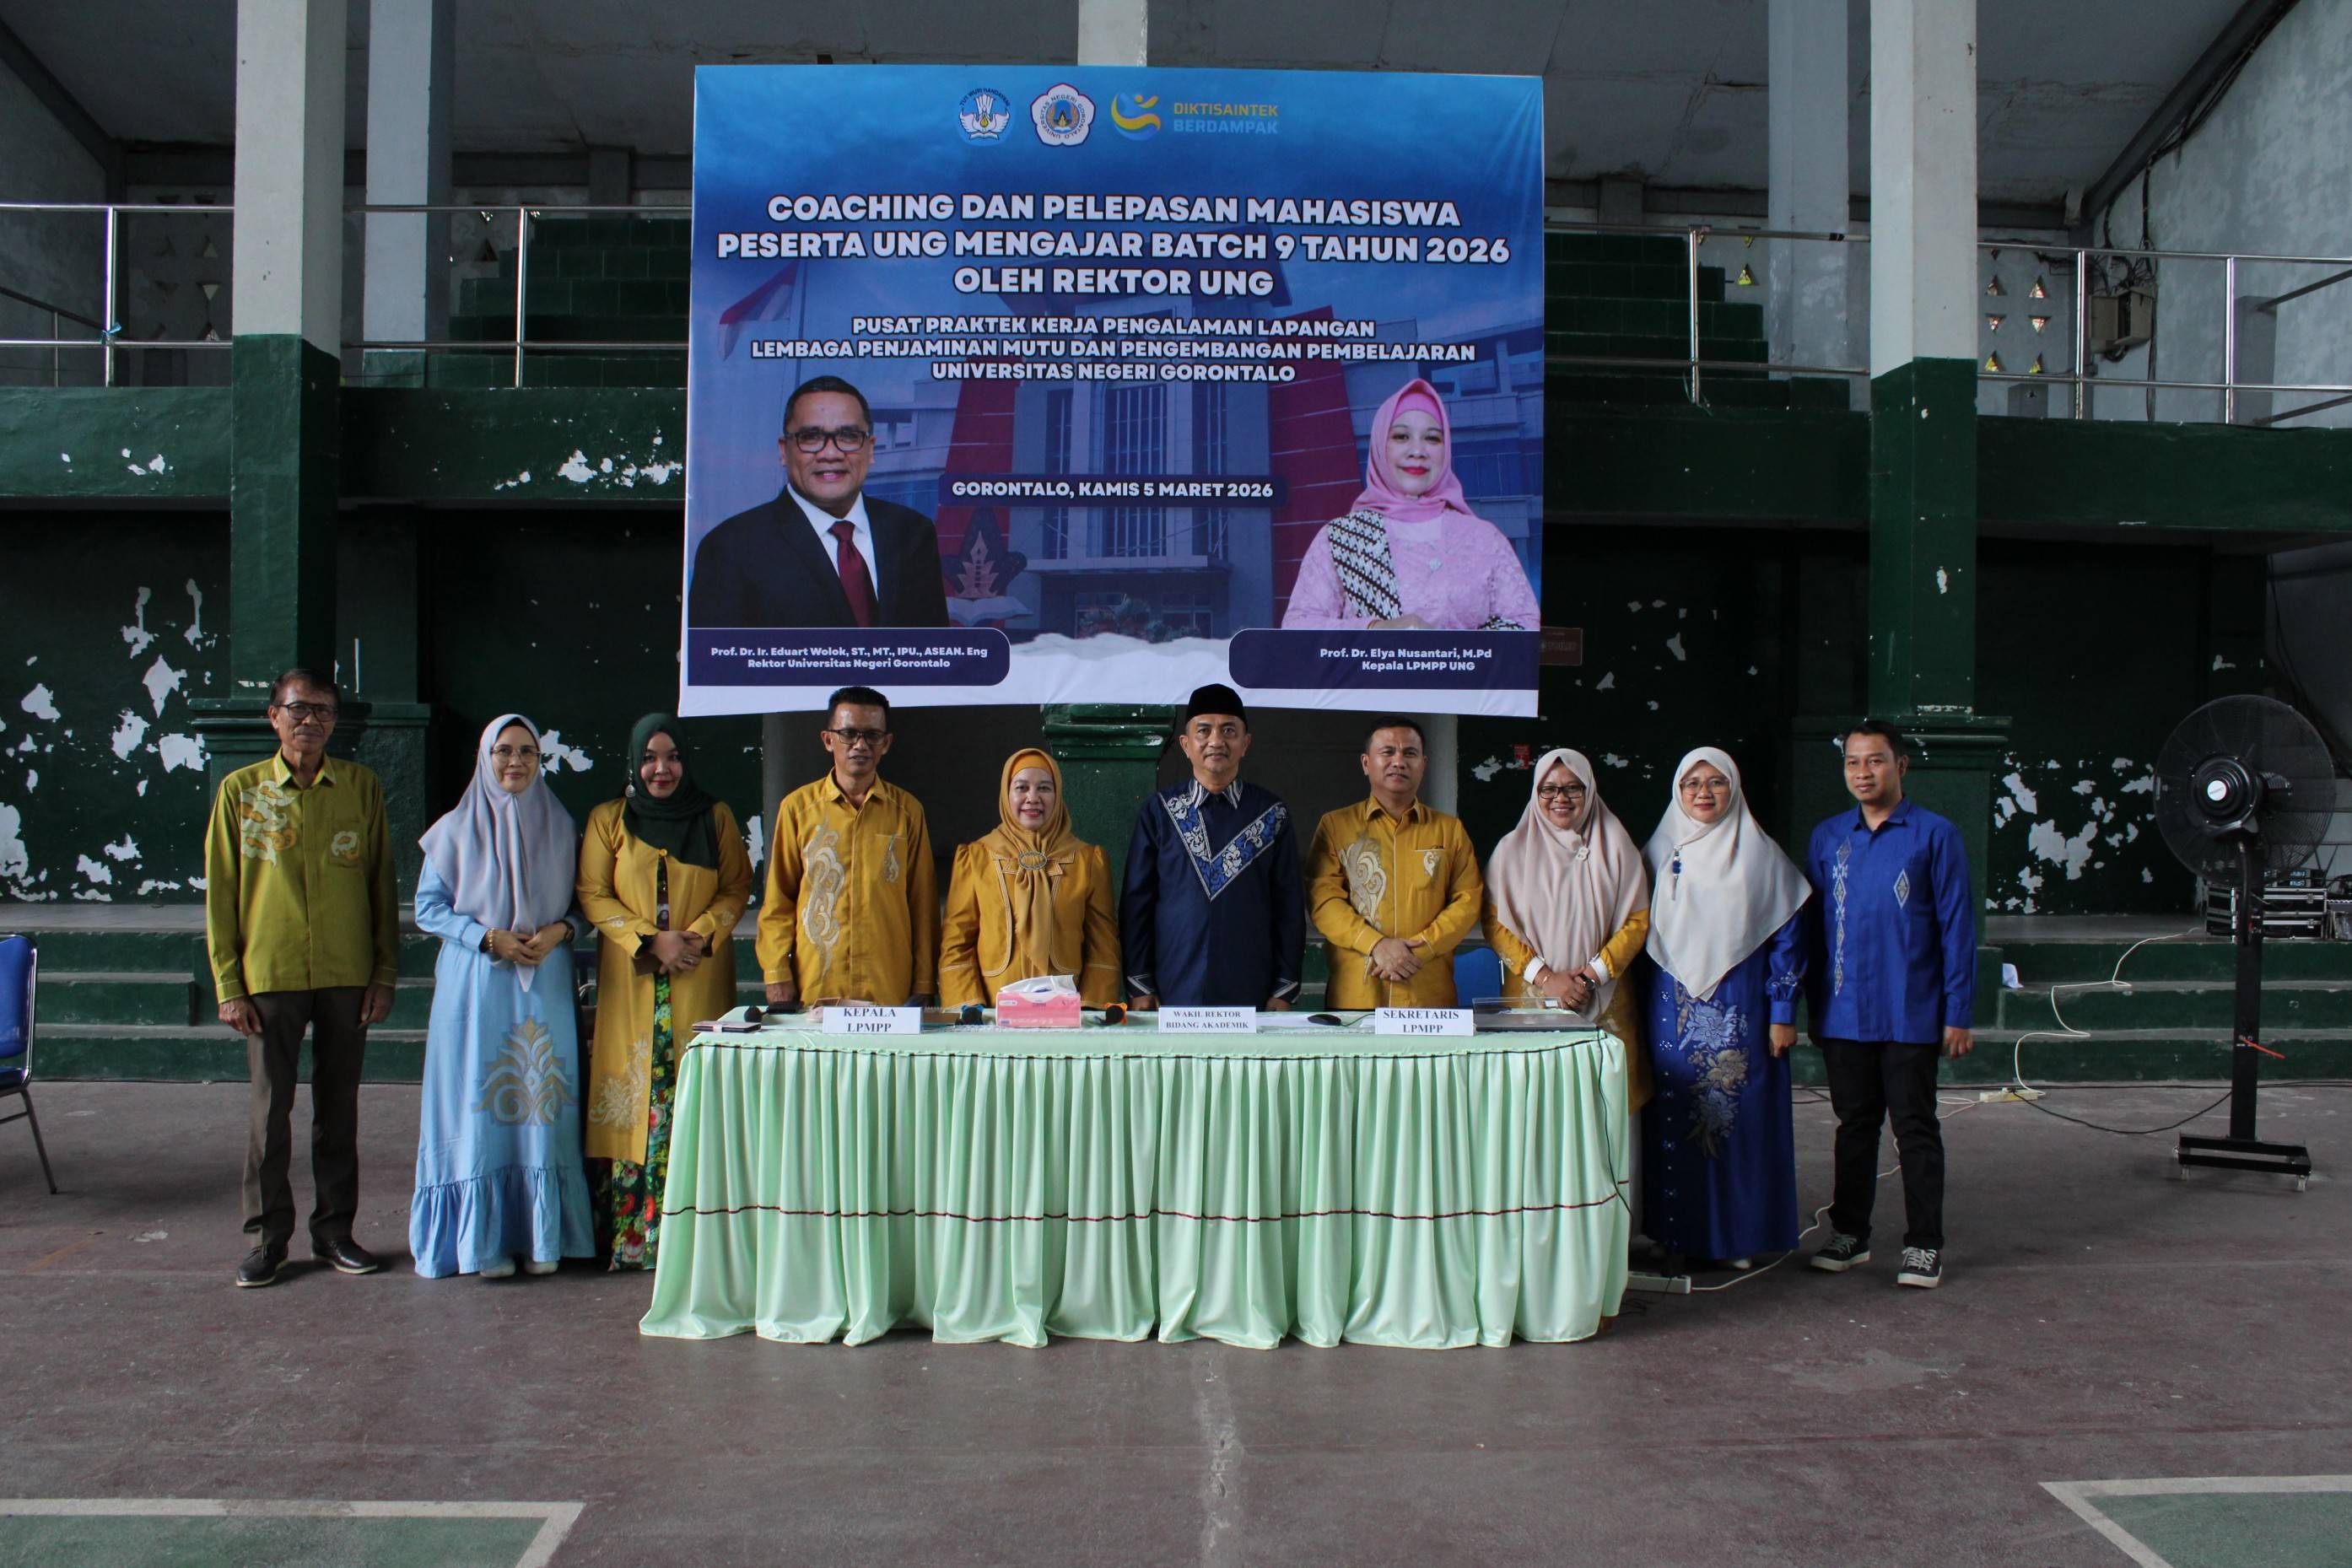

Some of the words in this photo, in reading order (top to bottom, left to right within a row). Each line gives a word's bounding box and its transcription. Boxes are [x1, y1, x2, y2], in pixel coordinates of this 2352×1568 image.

[1173, 102, 1278, 116] DIKTISAINTEK
[1173, 119, 1278, 134] BERDAMPAK
[768, 194, 954, 221] COACHING
[962, 194, 1034, 219] DAN
[1044, 195, 1238, 222] PELEPASAN
[1247, 198, 1460, 226] MAHASISWA
[718, 232, 866, 258] PESERTA
[873, 231, 947, 256] UNG
[955, 231, 1143, 256] MENGAJAR
[1152, 233, 1266, 259] BATCH
[1275, 234, 1295, 259] 9
[1301, 235, 1418, 261] TAHUN
[1426, 237, 1509, 263] 2026
[954, 267, 1044, 293] OLEH
[1053, 268, 1191, 294] REKTOR
[1200, 270, 1274, 296] UNG
[853, 317, 922, 334] PUSAT
[925, 316, 1027, 333] PRAKTEK
[1031, 317, 1098, 333] KERJA
[1103, 317, 1253, 335] PENGALAMAN
[1258, 320, 1374, 337] LAPANGAN
[752, 341, 854, 358] LEMBAGA
[858, 339, 997, 357] PENJAMINAN
[1002, 340, 1065, 356] MUTU
[1071, 340, 1116, 357] DAN
[1121, 341, 1302, 358] PENGEMBANGAN
[1307, 343, 1475, 361] PEMBELAJARAN
[932, 363, 1074, 380] UNIVERSITAS
[1078, 364, 1156, 380] NEGERI
[1160, 364, 1296, 381] GORONTALO
[952, 481, 1075, 499] GORONTALO,
[1078, 482, 1140, 497] KAMIS
[1143, 482, 1155, 497] 5
[1158, 482, 1224, 498] MARET
[1227, 482, 1274, 498] 2026
[710, 646, 738, 656] Prof.
[739, 647, 756, 656] Dr.
[757, 647, 769, 656] Ir.
[770, 646, 808, 656] Eduart
[809, 646, 850, 658] Wolok,
[850, 647, 871, 658] ST.,
[872, 647, 896, 658] MT.,
[897, 647, 923, 658] IPU.,
[924, 647, 965, 656] ASEAN.
[966, 647, 988, 658] Eng
[1319, 647, 1349, 658] Prof.
[1351, 648, 1368, 658] Dr.
[1370, 648, 1395, 660] Elya
[1397, 647, 1461, 660] Nusantari,
[1462, 648, 1492, 659] M.Pd
[747, 658, 786, 668] Rektor
[787, 658, 852, 668] Universitas
[853, 657, 892, 671] Negeri
[893, 658, 951, 668] Gorontalo
[1362, 660, 1404, 672] Kepala
[1405, 660, 1448, 671] LPMPP
[1448, 660, 1475, 671] UNG
[844, 1008, 896, 1017] KEPALA
[1383, 1009, 1459, 1020] SEKRETARIS
[848, 1022, 892, 1032] LPMPP
[1403, 1023, 1443, 1033] LPMPP
